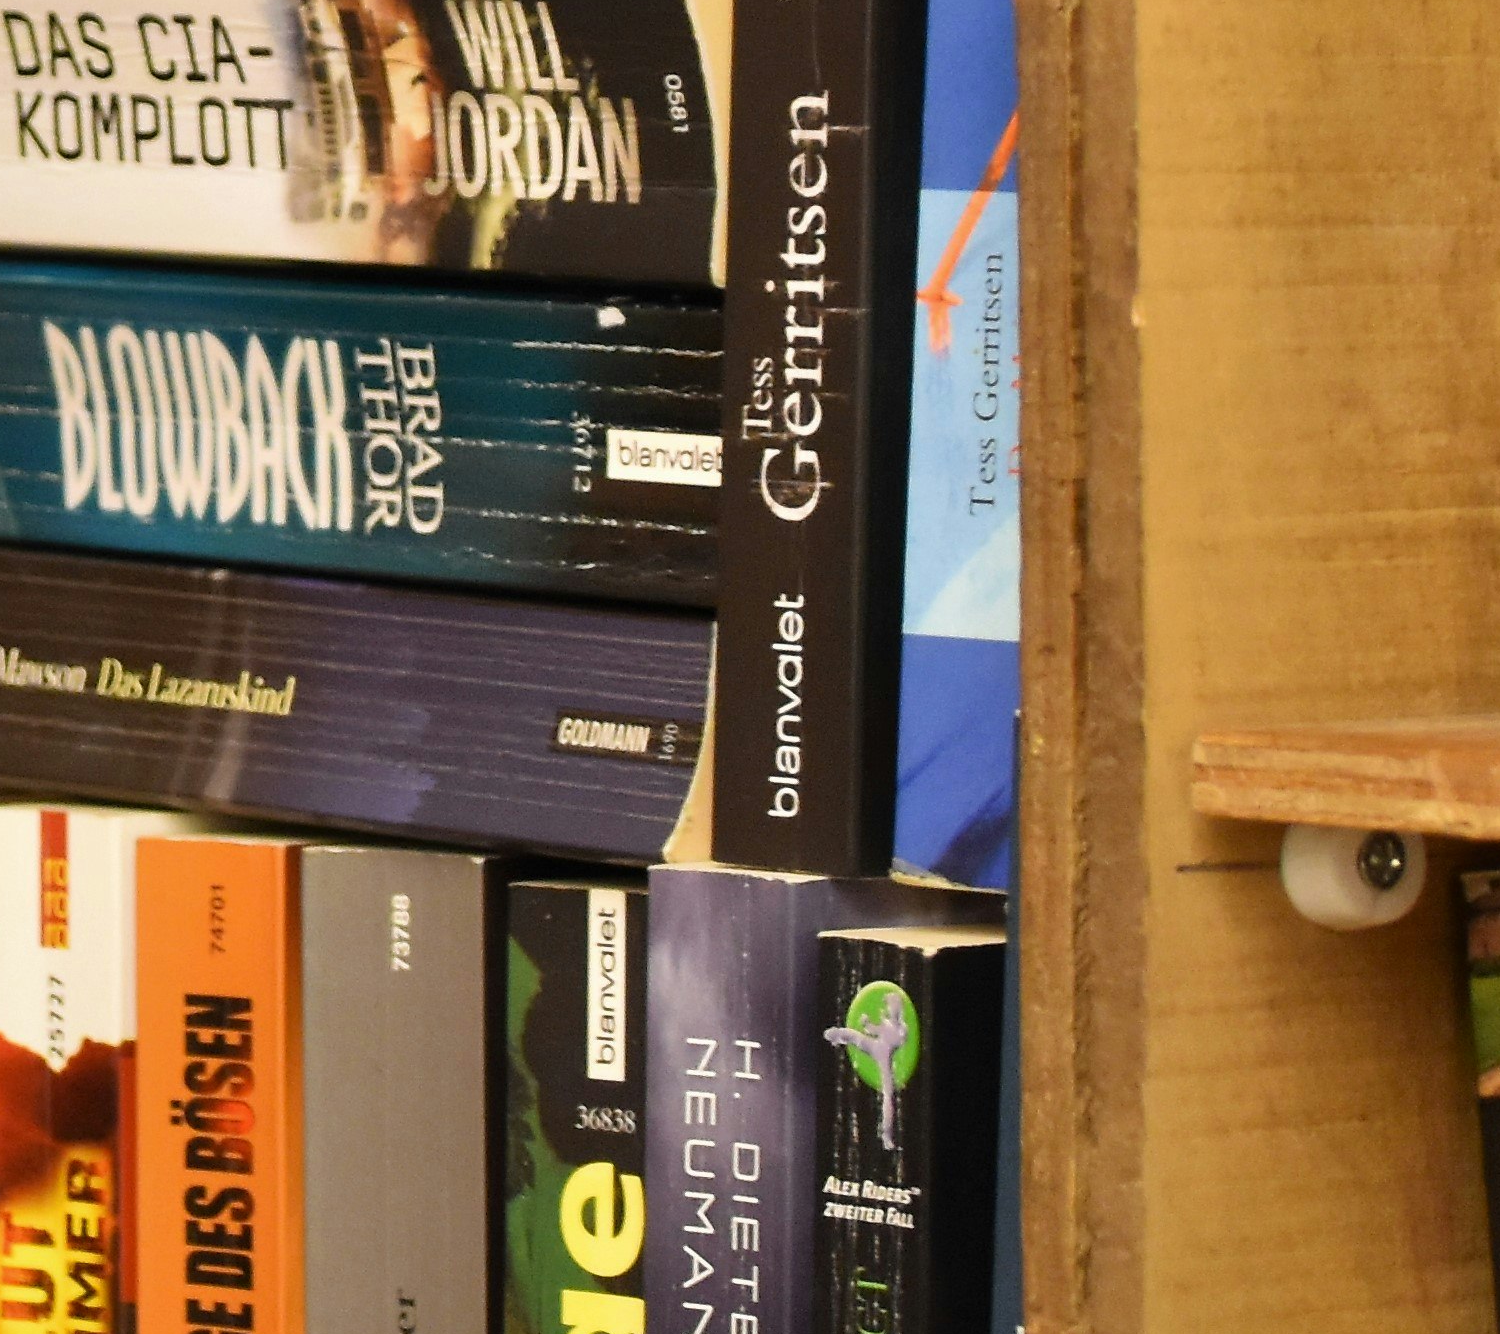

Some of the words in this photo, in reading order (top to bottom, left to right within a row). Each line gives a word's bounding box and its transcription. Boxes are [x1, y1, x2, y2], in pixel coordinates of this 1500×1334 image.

[2, 9, 115, 81] DAS
[141, 14, 273, 85] CIA-
[15, 94, 296, 172] KOMPLOTT
[425, 92, 643, 204] JORDAN
[760, 87, 832, 523] Gerritsen
[973, 252, 1007, 423] Gerritsen
[42, 319, 356, 533] BLOWBACK
[354, 337, 404, 535] THOR
[400, 340, 446, 537] BRAD
[742, 356, 774, 441] Tess
[969, 435, 998, 518] Tess
[96, 655, 146, 699] Das
[147, 662, 296, 717] Lazaruskind
[556, 715, 650, 756] GOLDMANN
[767, 593, 806, 819] blanvalet
[596, 907, 617, 1066] blanvalet
[169, 993, 256, 1178] BÖSEN
[574, 1104, 636, 1135] 36838
[732, 1039, 761, 1099] H.
[184, 1188, 256, 1293] DES
[824, 1203, 884, 1226] ZWEITER
